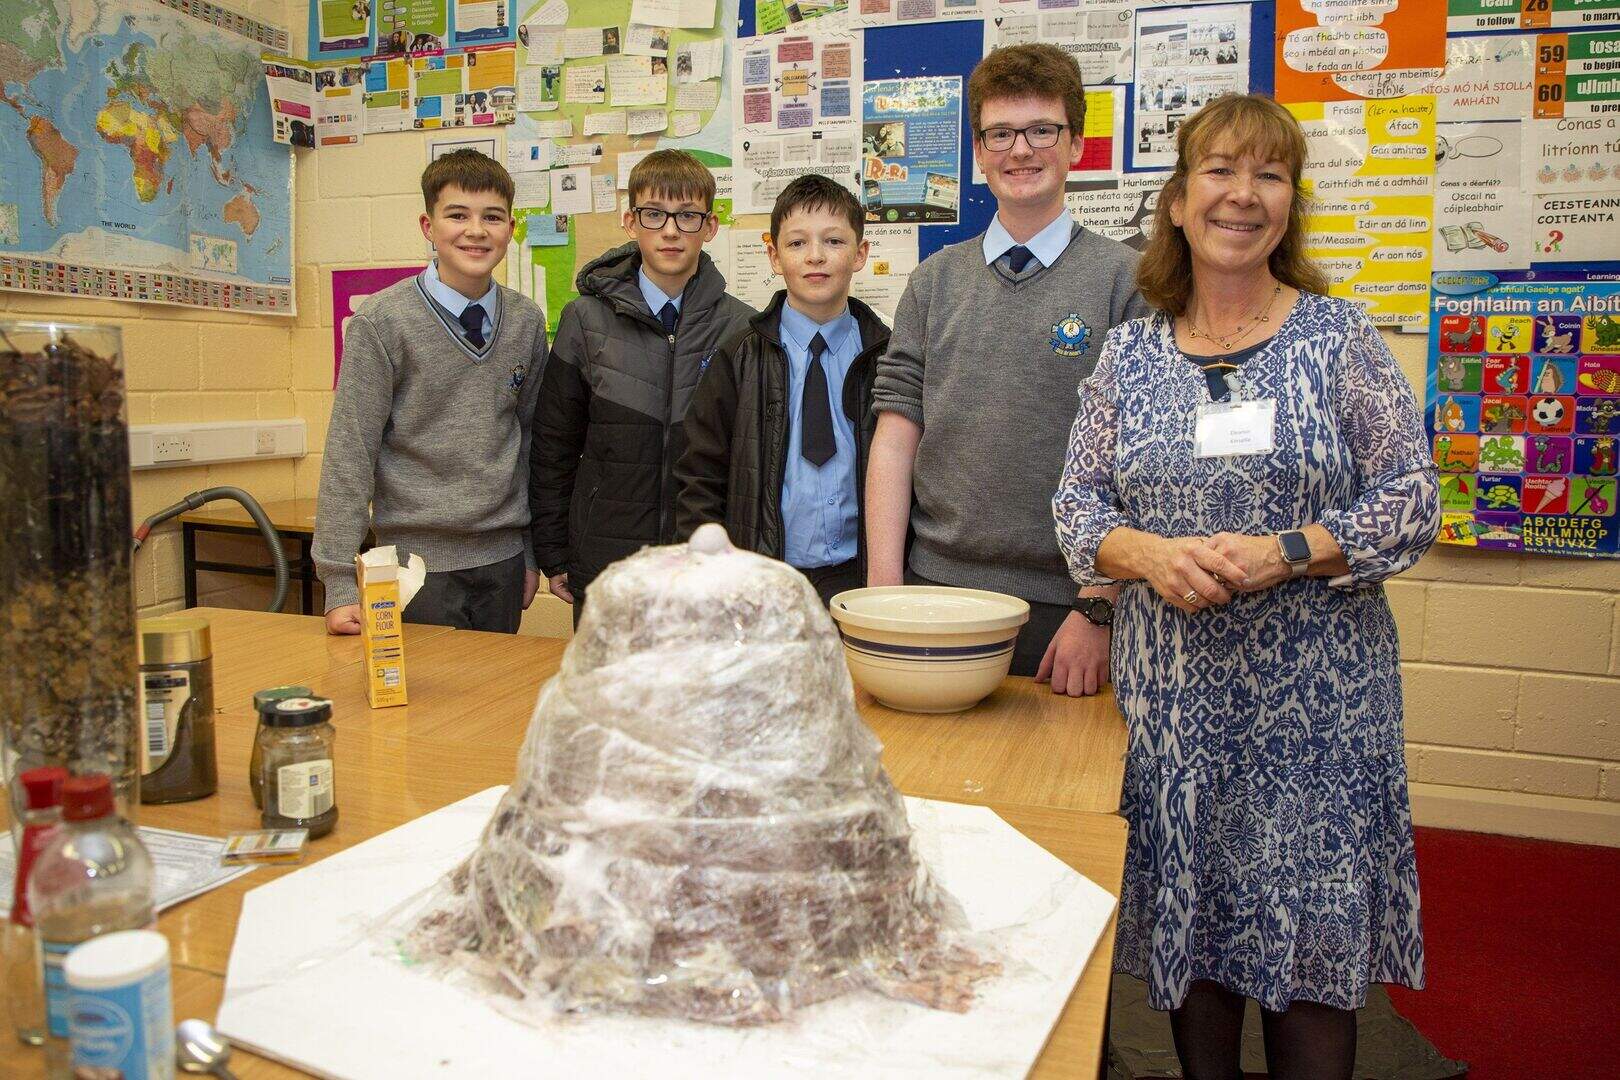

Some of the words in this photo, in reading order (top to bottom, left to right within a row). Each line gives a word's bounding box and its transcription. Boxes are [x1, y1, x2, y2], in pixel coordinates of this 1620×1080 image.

[1476, 17, 1486, 26] to
[1487, 16, 1516, 26] follow
[1582, 12, 1592, 22] to
[1353, 30, 1386, 40] chasta
[1308, 46, 1336, 56] mbéal
[1338, 48, 1350, 56] an
[1539, 44, 1565, 64] 59
[1305, 63, 1313, 72] le
[1316, 62, 1339, 71] fada
[1355, 61, 1364, 70] lá
[1582, 62, 1592, 71] to
[1336, 73, 1348, 82] Ba
[1385, 72, 1396, 82] go
[1399, 69, 1439, 79] mbeimís
[1454, 80, 1471, 93] MÓ
[1473, 80, 1490, 92] NÁ
[1493, 80, 1533, 92] SIOLLA
[1537, 84, 1563, 102] 60
[1452, 94, 1500, 107] AMHÁIN
[1590, 104, 1600, 113] to
[1388, 120, 1419, 130] Áfach
[1556, 118, 1602, 132] Conas
[1606, 120, 1616, 129] a
[1392, 145, 1427, 155] amhras
[1542, 141, 1599, 157] litríonn
[1328, 158, 1342, 168] dul
[1318, 178, 1364, 189] Caithfidh
[1366, 177, 1380, 187] mé
[1392, 176, 1428, 186] admháil
[1440, 180, 1460, 188] Conas
[1470, 178, 1501, 187] déarfá??
[1077, 192, 1094, 202] níos
[1096, 192, 1120, 200] néata
[1122, 191, 1143, 200] agus
[1451, 192, 1482, 202] Oscail
[1484, 192, 1496, 200] na
[1078, 204, 1120, 214] faiseanta
[1124, 203, 1134, 212] ná
[1359, 202, 1370, 211] rá
[1443, 202, 1504, 215] cóipleabhair
[1084, 218, 1110, 227] bhean
[1113, 216, 1128, 225] eile
[1358, 220, 1378, 229] Idir
[1394, 219, 1406, 228] dá
[1409, 218, 1426, 228] linn
[1537, 212, 1615, 225] COITEANTA
[114, 222, 136, 230] WORLD
[874, 228, 888, 236] dán
[889, 228, 902, 236] seo
[1372, 252, 1384, 260] Ar
[1387, 252, 1404, 260] aon
[1406, 249, 1422, 260] nós
[1355, 261, 1362, 269] &
[1354, 284, 1394, 293] Feictear
[1397, 282, 1427, 292] domsa
[1526, 286, 1560, 295] Gaeilge
[1561, 285, 1586, 294] agat?
[1434, 296, 1532, 316] Foghlaim
[1537, 300, 1564, 312] an
[1398, 314, 1422, 322] scoir
[376, 610, 394, 620] CORN
[376, 620, 395, 631] FLOUR
